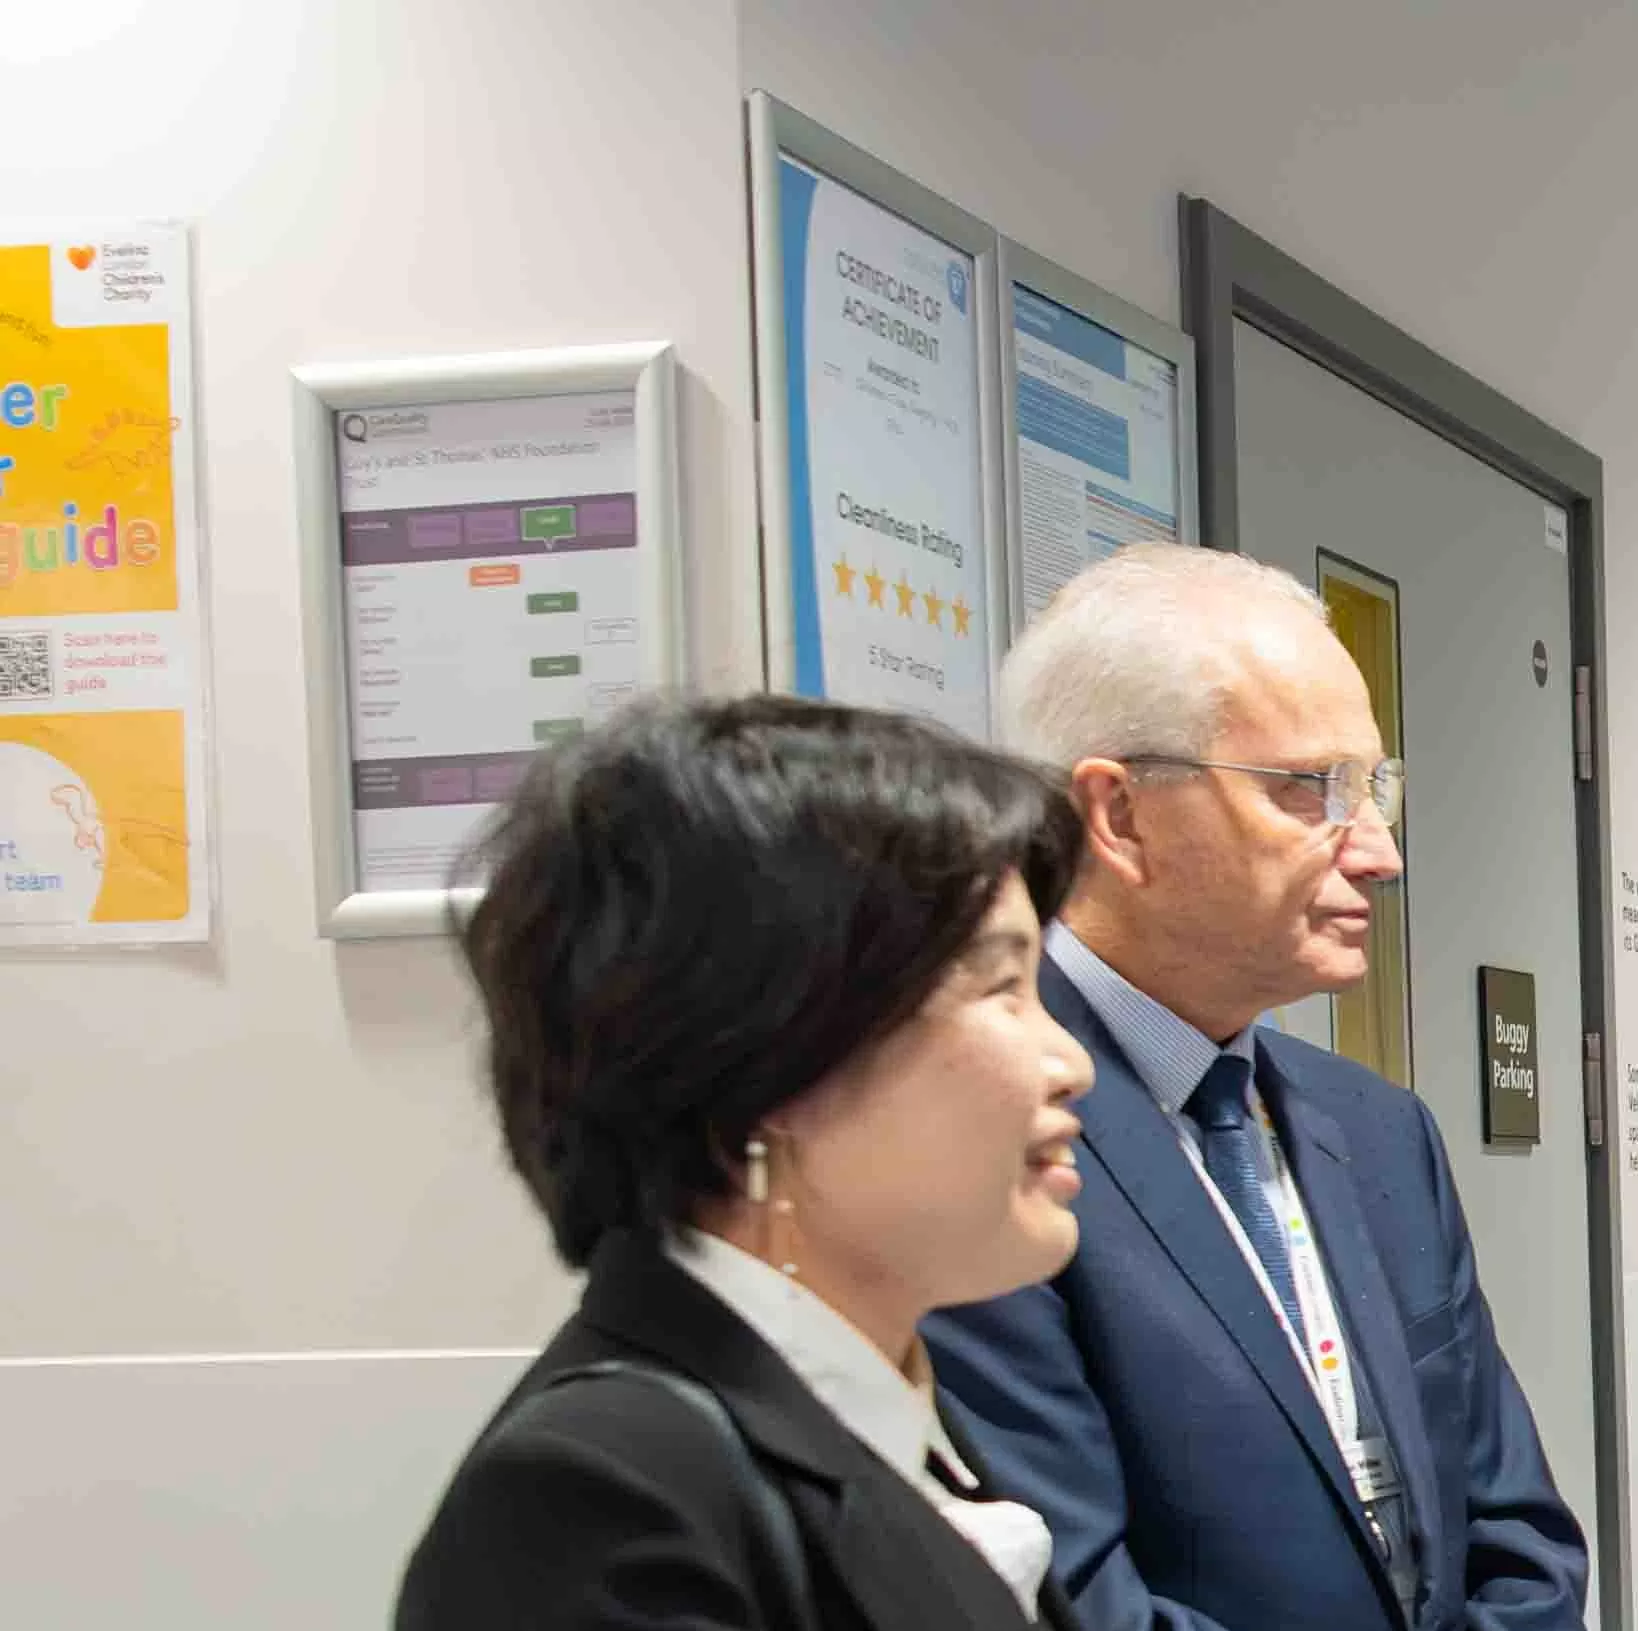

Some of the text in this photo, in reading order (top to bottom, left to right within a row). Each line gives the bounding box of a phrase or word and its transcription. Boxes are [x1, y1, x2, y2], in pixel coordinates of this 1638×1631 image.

[842, 295, 940, 363] ACHIEVEMENT
[1495, 1013, 1530, 1053] Buggy
[1493, 1060, 1535, 1099] Parking
